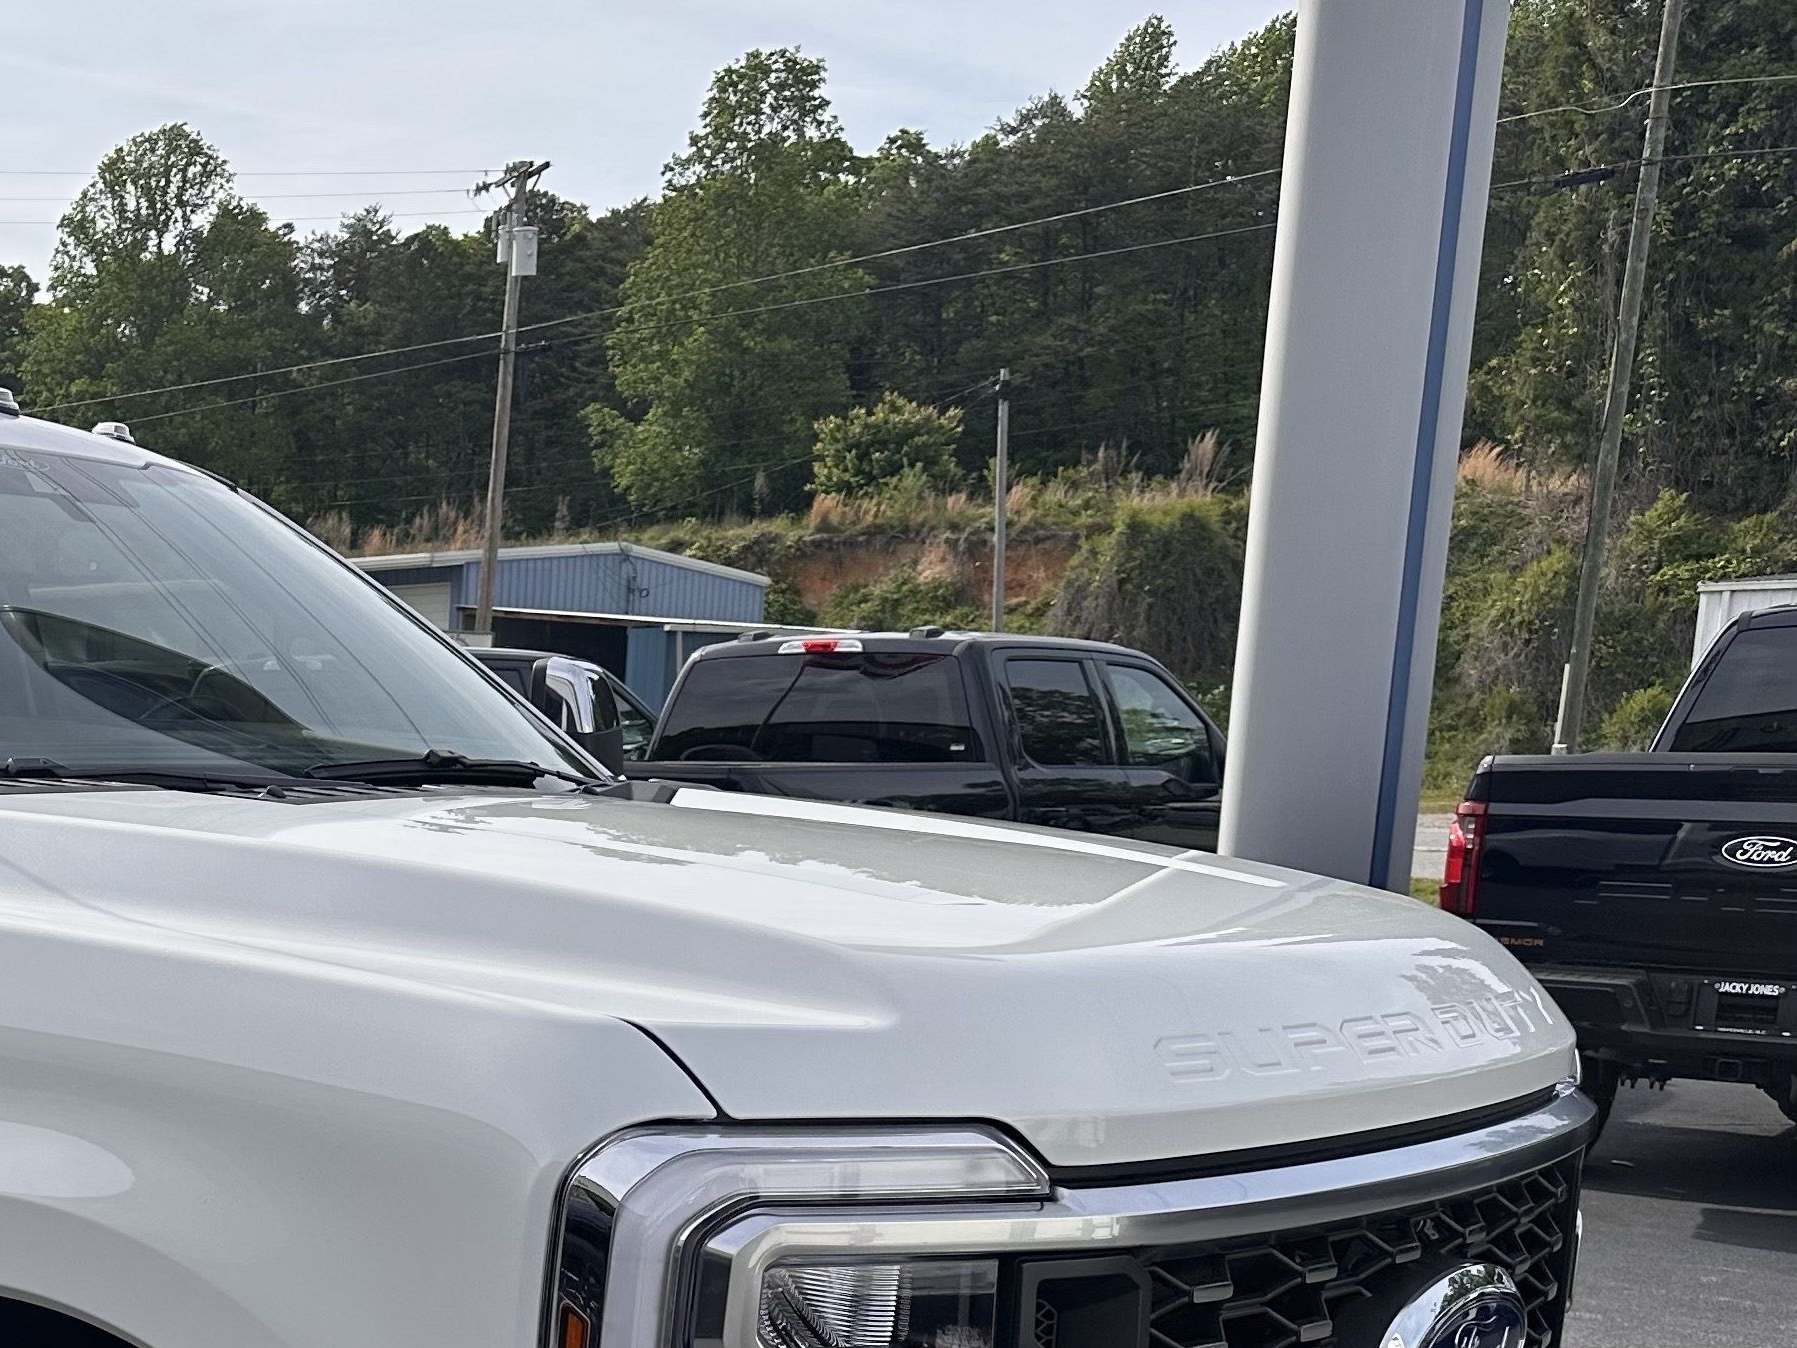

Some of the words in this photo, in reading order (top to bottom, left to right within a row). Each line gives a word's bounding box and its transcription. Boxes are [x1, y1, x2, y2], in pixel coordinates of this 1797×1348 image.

[1735, 839, 1794, 862] Ford
[1717, 981, 1749, 995] JACKY
[1747, 983, 1781, 996] JONES
[1153, 1008, 1444, 1083] SUPER
[1430, 986, 1555, 1050] DUTY
